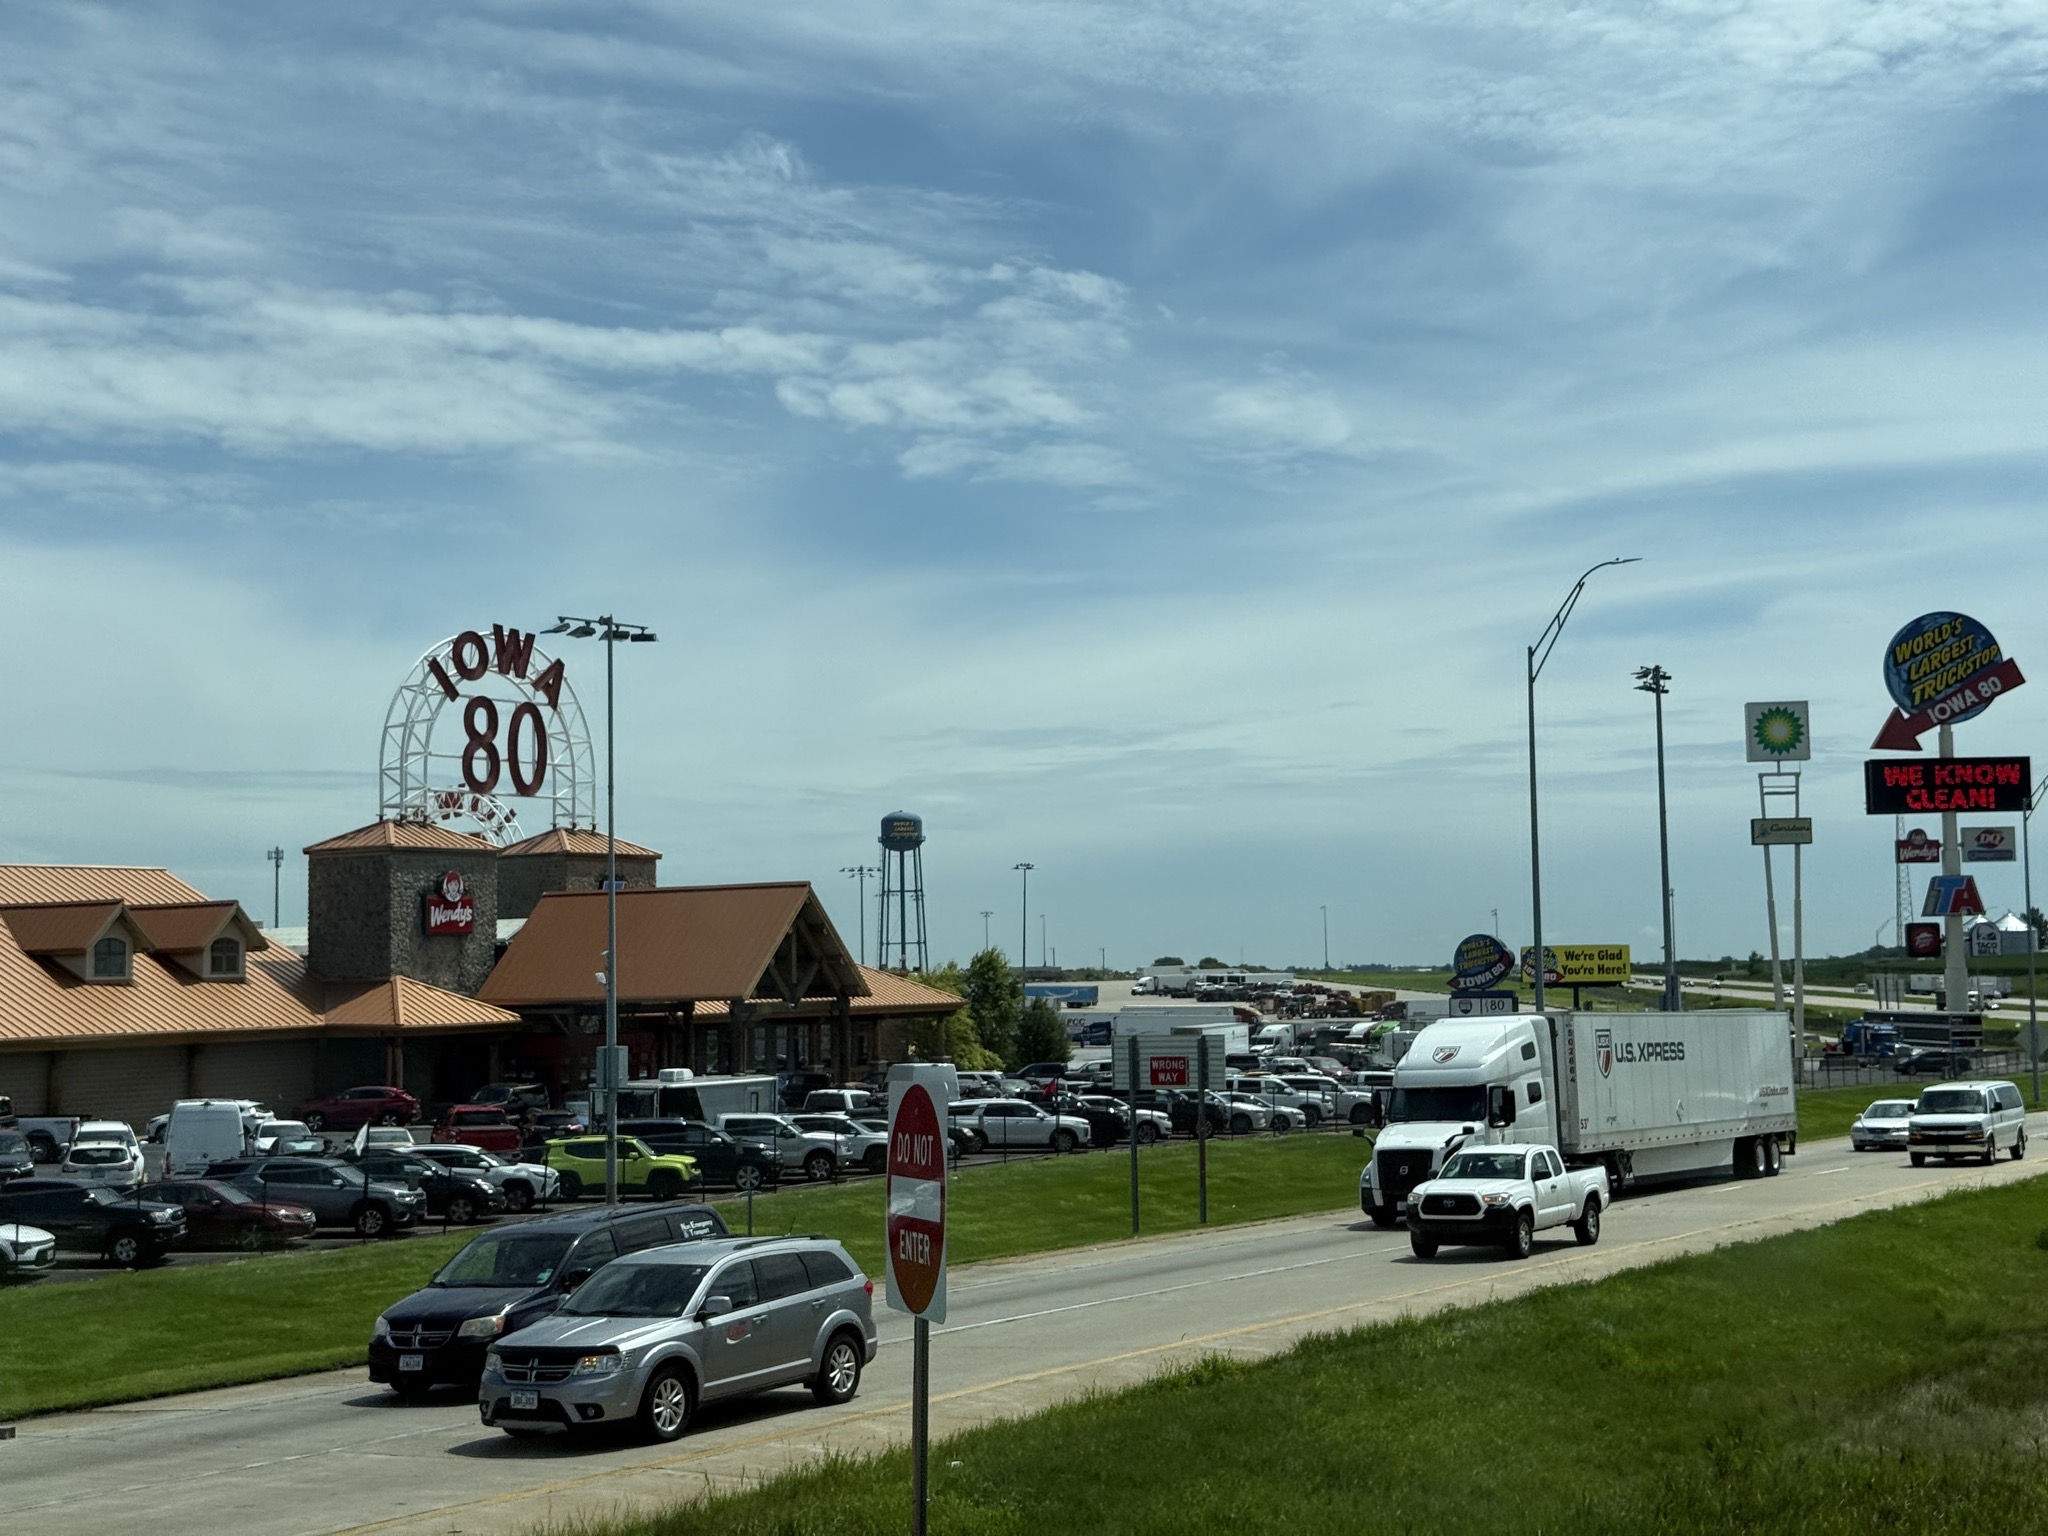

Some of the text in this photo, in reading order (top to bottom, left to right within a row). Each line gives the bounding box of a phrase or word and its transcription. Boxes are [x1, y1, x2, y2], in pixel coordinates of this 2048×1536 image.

[1895, 618, 1962, 664] WORLD'S
[428, 623, 565, 711] IOWA
[1910, 634, 1974, 681] LARGEST
[1911, 644, 1999, 705] TRUCKSTOP
[1927, 676, 2002, 723] IOWA 80
[462, 695, 548, 797] 80
[1884, 764, 2020, 786] WE KNOW
[1906, 788, 1995, 809] CLEAN!
[1980, 833, 2001, 845] DQ
[1900, 845, 1938, 861] Wendy's
[1934, 875, 1985, 916] TA
[430, 902, 473, 927] Wendy's
[1564, 950, 1594, 961] We're
[1598, 949, 1622, 961] Glad
[1457, 963, 1505, 988] IOWA 80
[1562, 963, 1626, 976] You're Here!
[1614, 1041, 1685, 1063] U.S. XPRESS
[1151, 1060, 1185, 1070] WRONG
[1158, 1072, 1179, 1082] WAY
[897, 1132, 934, 1167] DO NOT
[899, 1228, 931, 1267] ENTER
